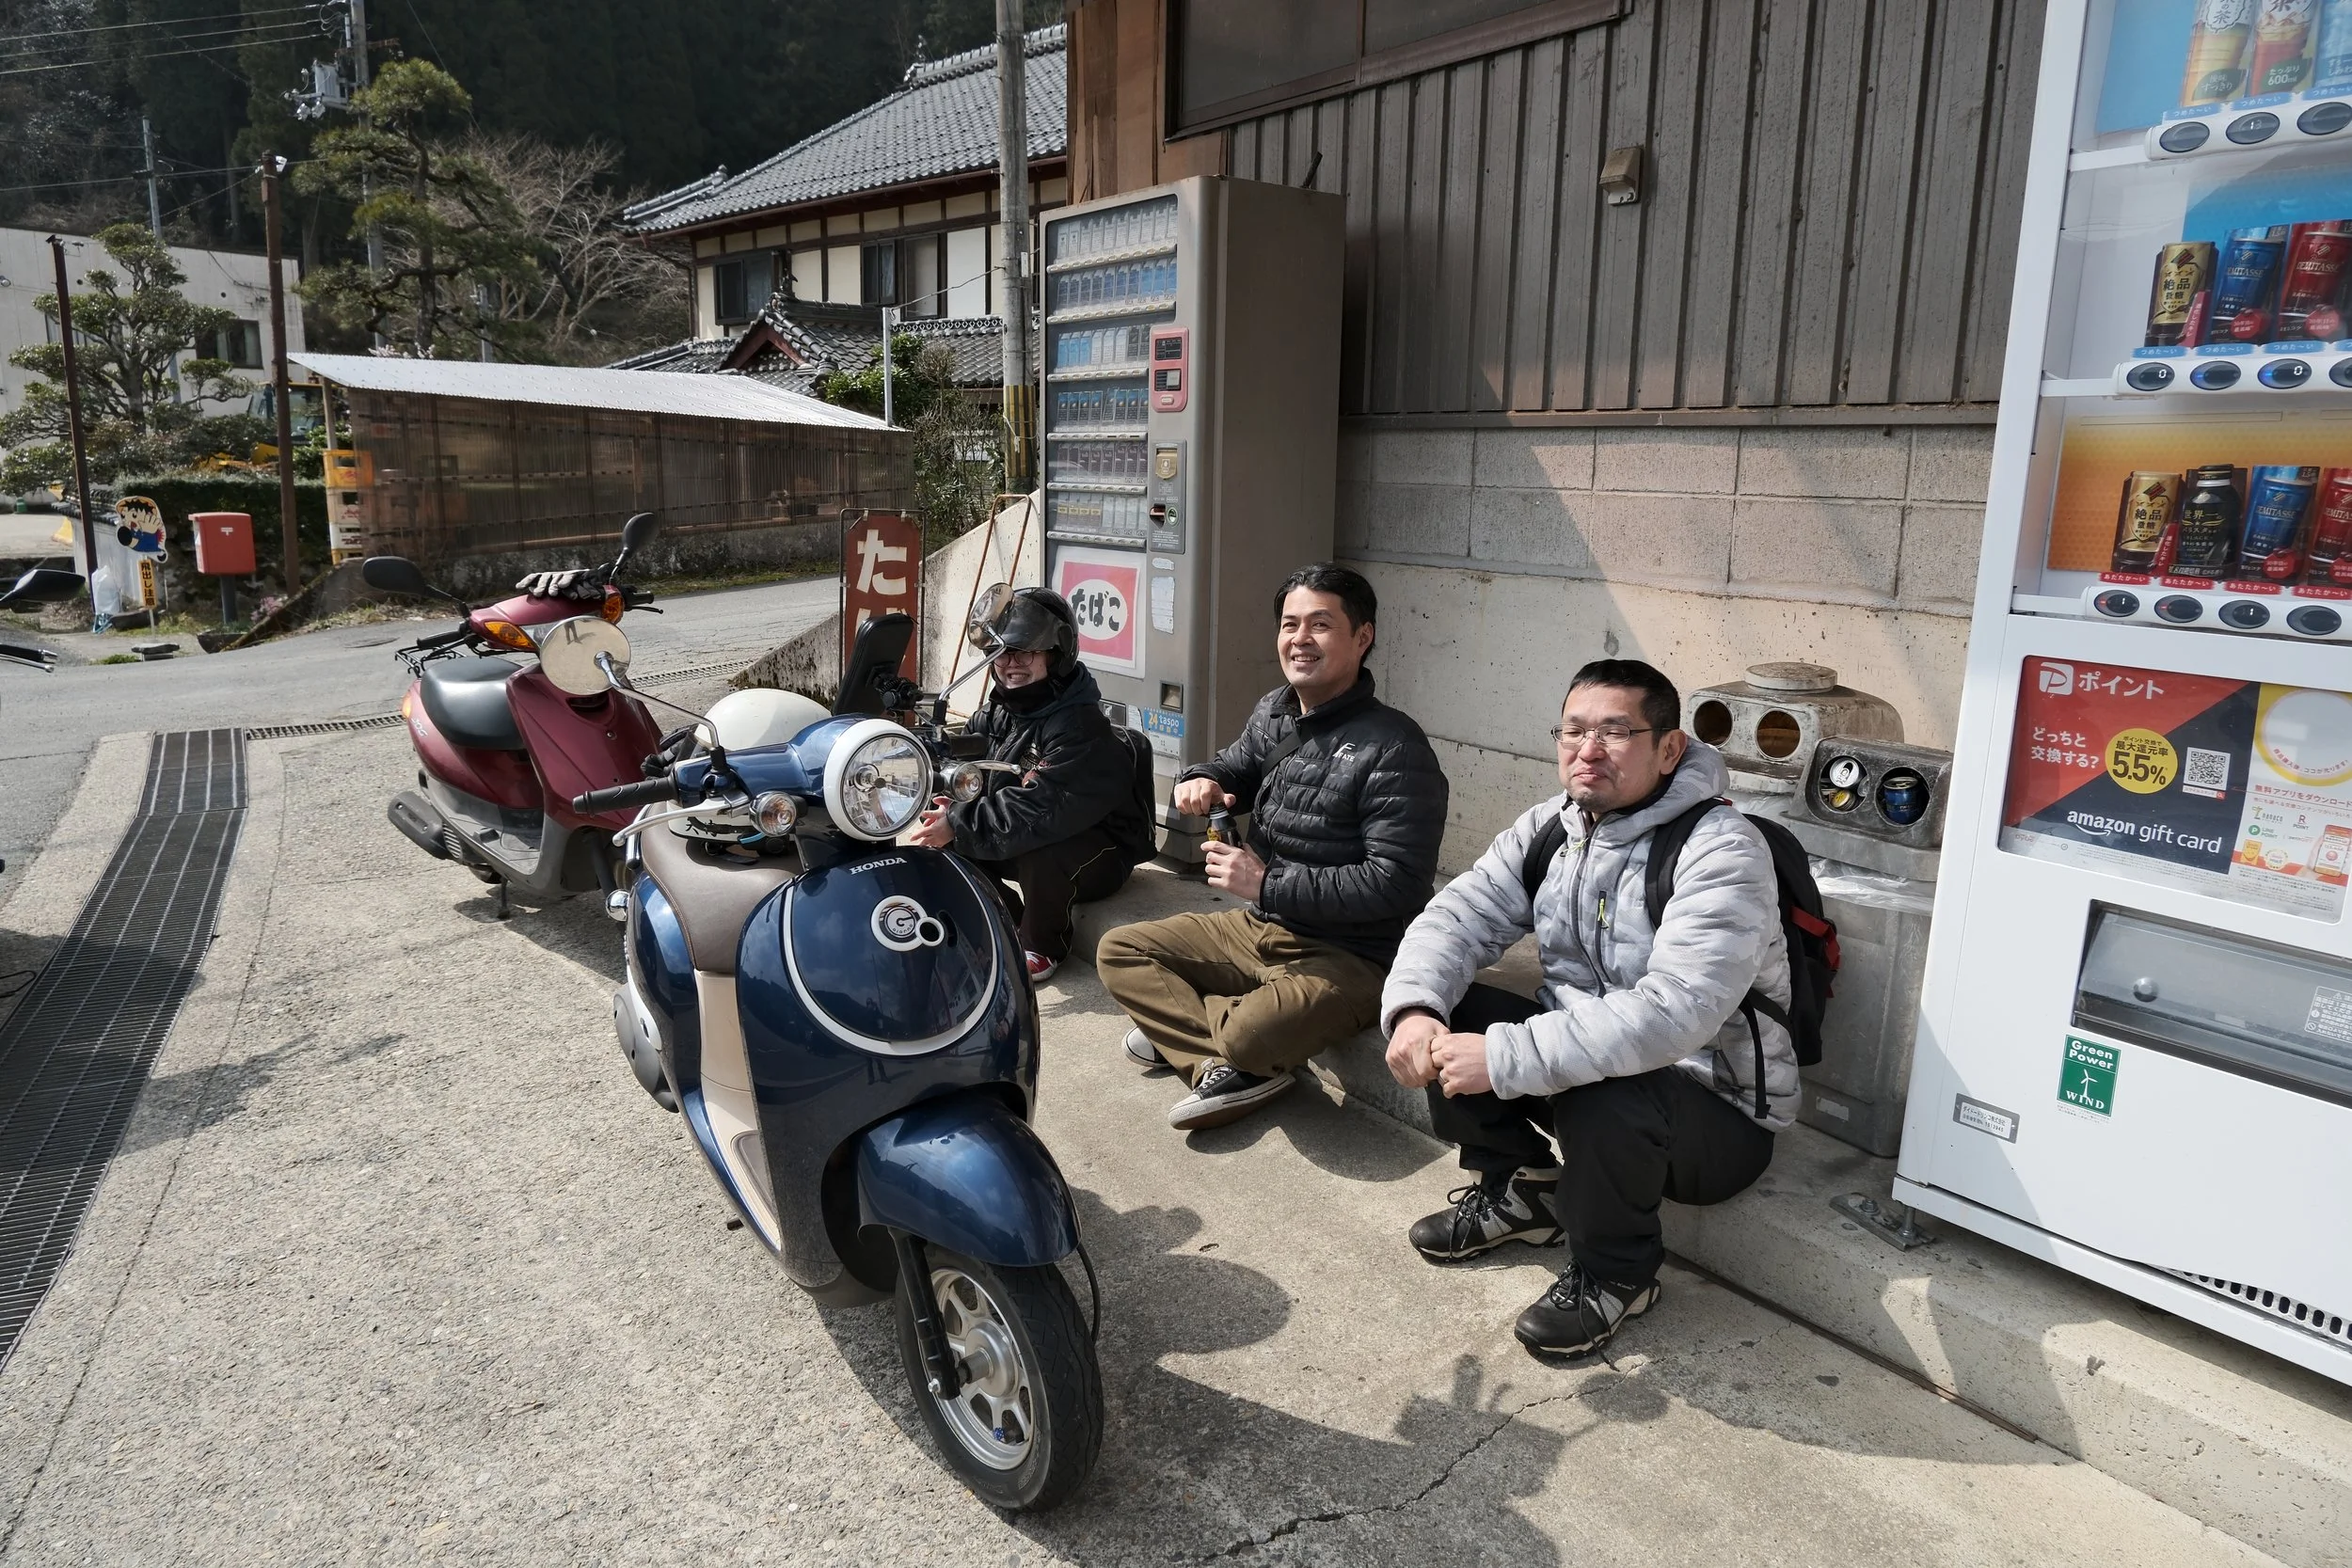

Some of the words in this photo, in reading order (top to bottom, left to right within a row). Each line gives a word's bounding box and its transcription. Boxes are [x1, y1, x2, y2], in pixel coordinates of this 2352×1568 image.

[2213, 0, 2234, 24] の茶
[2269, 65, 2299, 75] たっぷり
[2267, 74, 2297, 87] 600ml
[2227, 266, 2264, 277] EMITASSE
[2163, 277, 2190, 291] 絶品
[2134, 509, 2162, 521] 絶品
[2185, 510, 2221, 519] 世界一の
[141, 562, 155, 607] 飛出し注意
[1071, 588, 1120, 631] たばこ
[2078, 671, 2164, 700] ポイント
[1149, 712, 1158, 725] 24
[1158, 715, 1180, 728] taspo
[2032, 726, 2087, 748] どっちと
[2122, 736, 2163, 746] ポイント交換で
[2031, 746, 2100, 768] 交換する?
[2116, 740, 2169, 757] 最大還元率
[2112, 751, 2167, 785] 5.5%
[2255, 784, 2352, 807] 無料アプリをダウンロード
[2067, 810, 2136, 836] amazon
[2139, 823, 2175, 844] gift
[2177, 836, 2222, 854] card
[849, 857, 908, 876] HONDA
[2069, 1049, 2114, 1069] Power
[2071, 1039, 2113, 1060] Green
[2066, 1090, 2105, 1110] WIND
